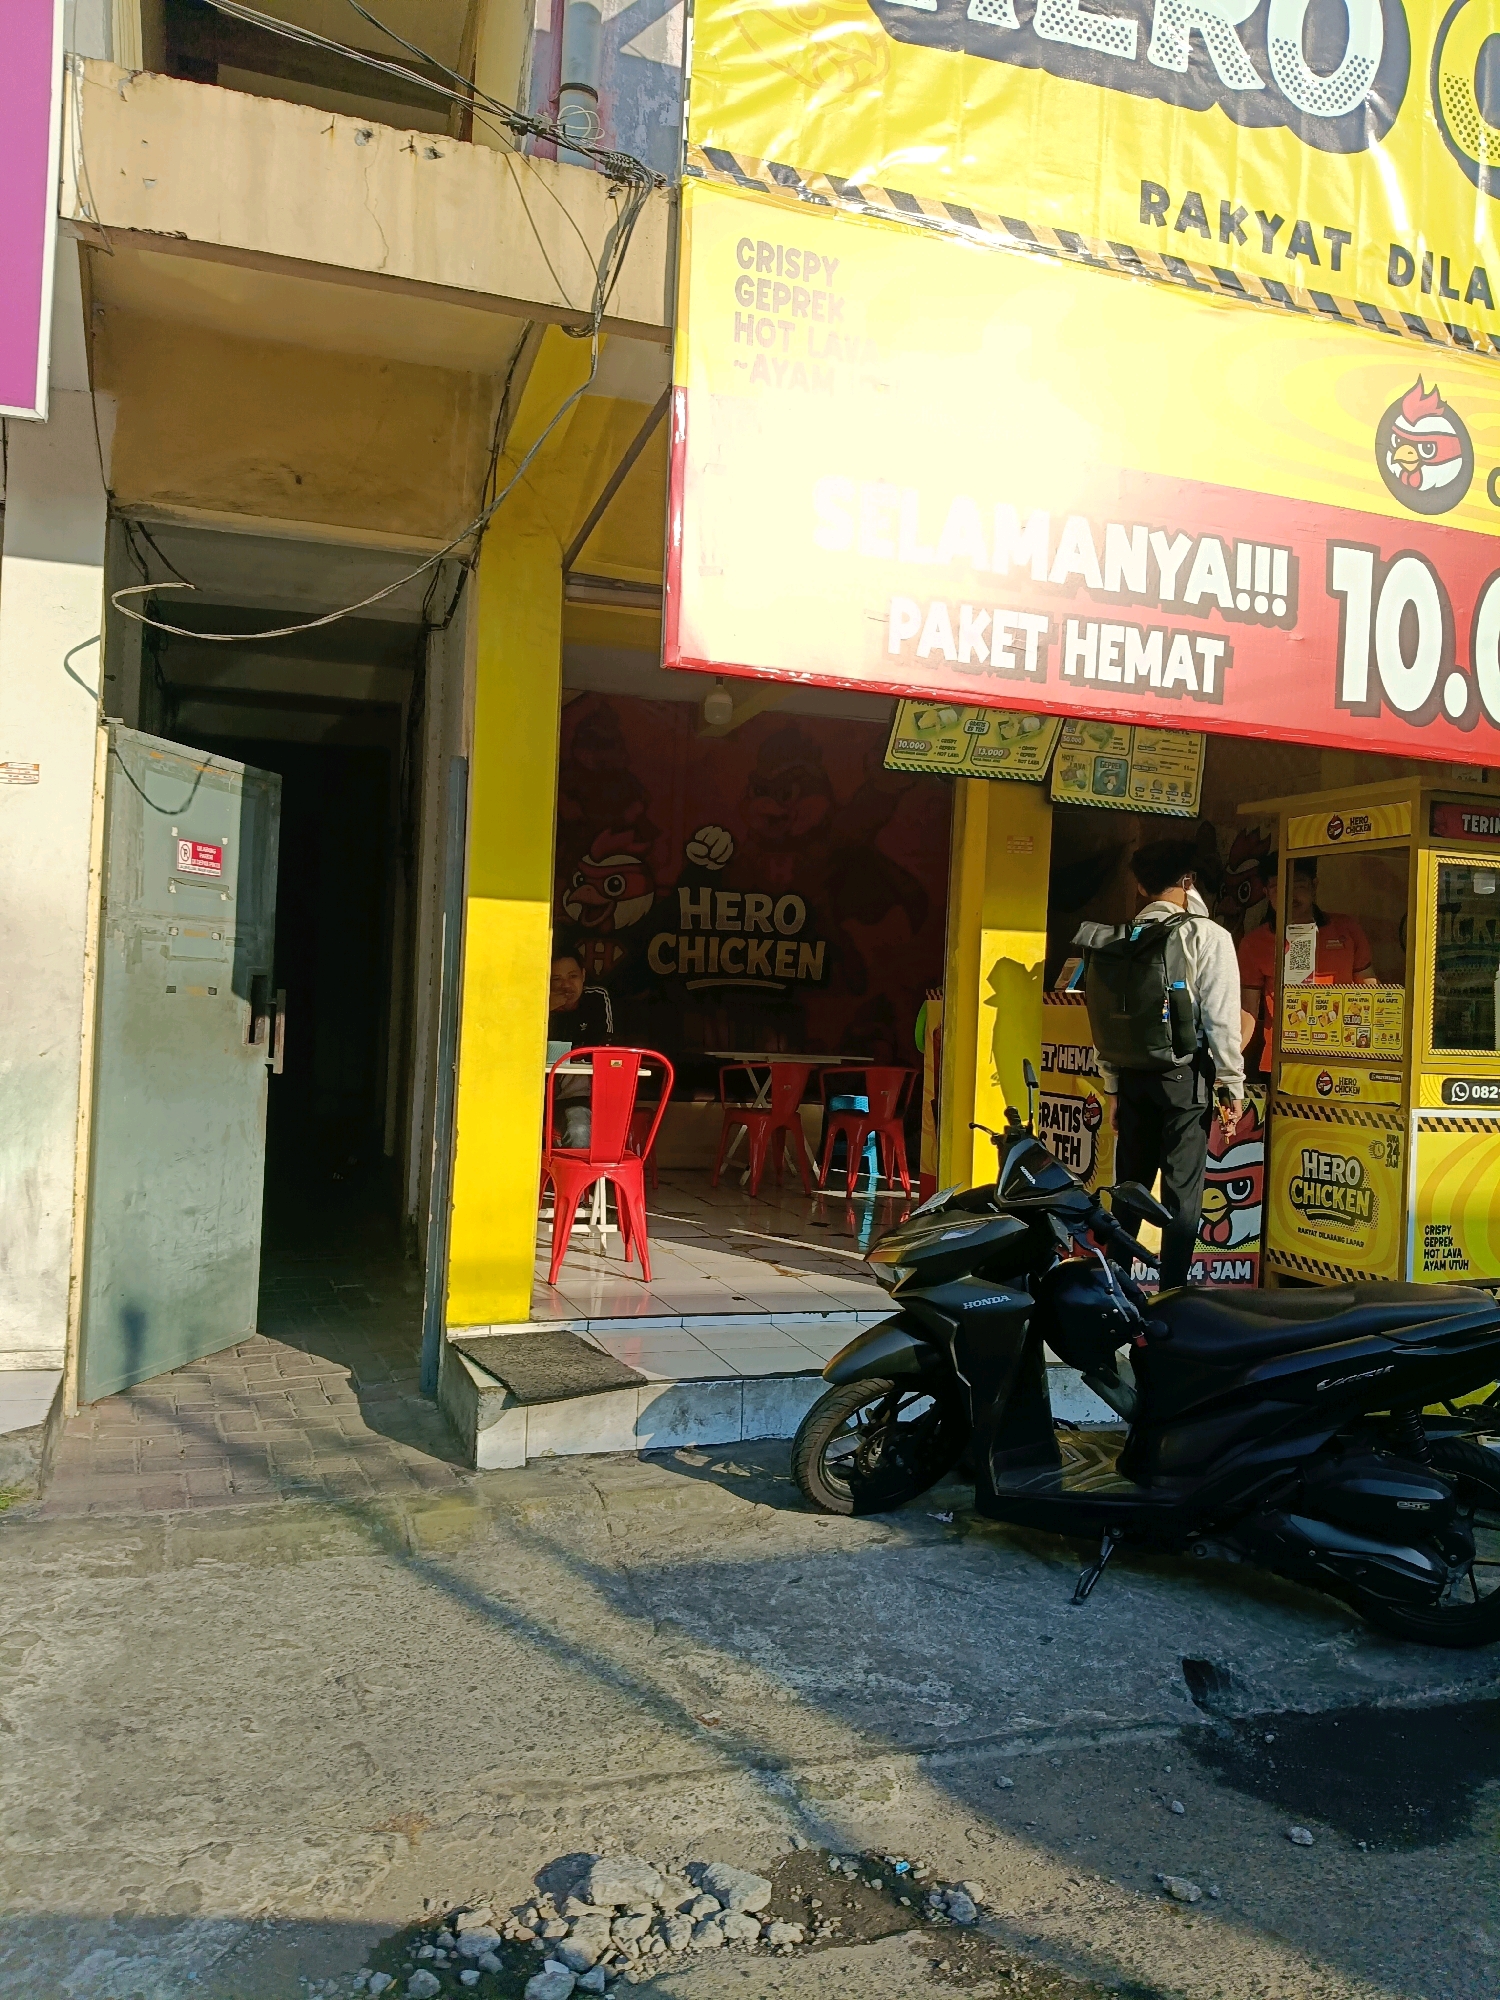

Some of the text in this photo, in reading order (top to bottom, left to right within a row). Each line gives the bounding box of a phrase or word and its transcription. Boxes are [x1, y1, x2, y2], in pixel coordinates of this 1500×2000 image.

[1140, 179, 1496, 311] RAKYAT DILA
[736, 237, 840, 287] CRISPY
[734, 275, 845, 324] GEPREK
[733, 311, 878, 366] HOT LAVA
[812, 476, 1289, 617] SELAMANYA!!!
[887, 596, 1225, 694] PAKET HEMAT
[898, 740, 926, 750] 10.000
[977, 748, 1004, 757] 13.000
[1345, 823, 1372, 834] CHICKEN
[1349, 815, 1369, 826] HERO
[677, 886, 807, 936] HERO
[647, 932, 826, 981] CHICKEN
[1334, 1085, 1361, 1095] CHICKEN
[1339, 1076, 1357, 1087] HERO
[1039, 1102, 1082, 1133] RATIS
[1053, 1133, 1082, 1168] TEH
[1387, 1143, 1400, 1159] 24
[1019, 1165, 1036, 1185] HONDA
[1302, 1151, 1361, 1186] HERO
[1290, 1178, 1371, 1217] CHICKEN
[1424, 1225, 1452, 1235] CRISPY
[1345, 1237, 1365, 1248] LAPAR
[1423, 1236, 1454, 1247] GEPREK
[1423, 1247, 1463, 1259] HOT LAVA
[1209, 1260, 1251, 1280] JAM
[1423, 1259, 1469, 1271] AYAM UTUH
[962, 1294, 1012, 1310] HONDA
